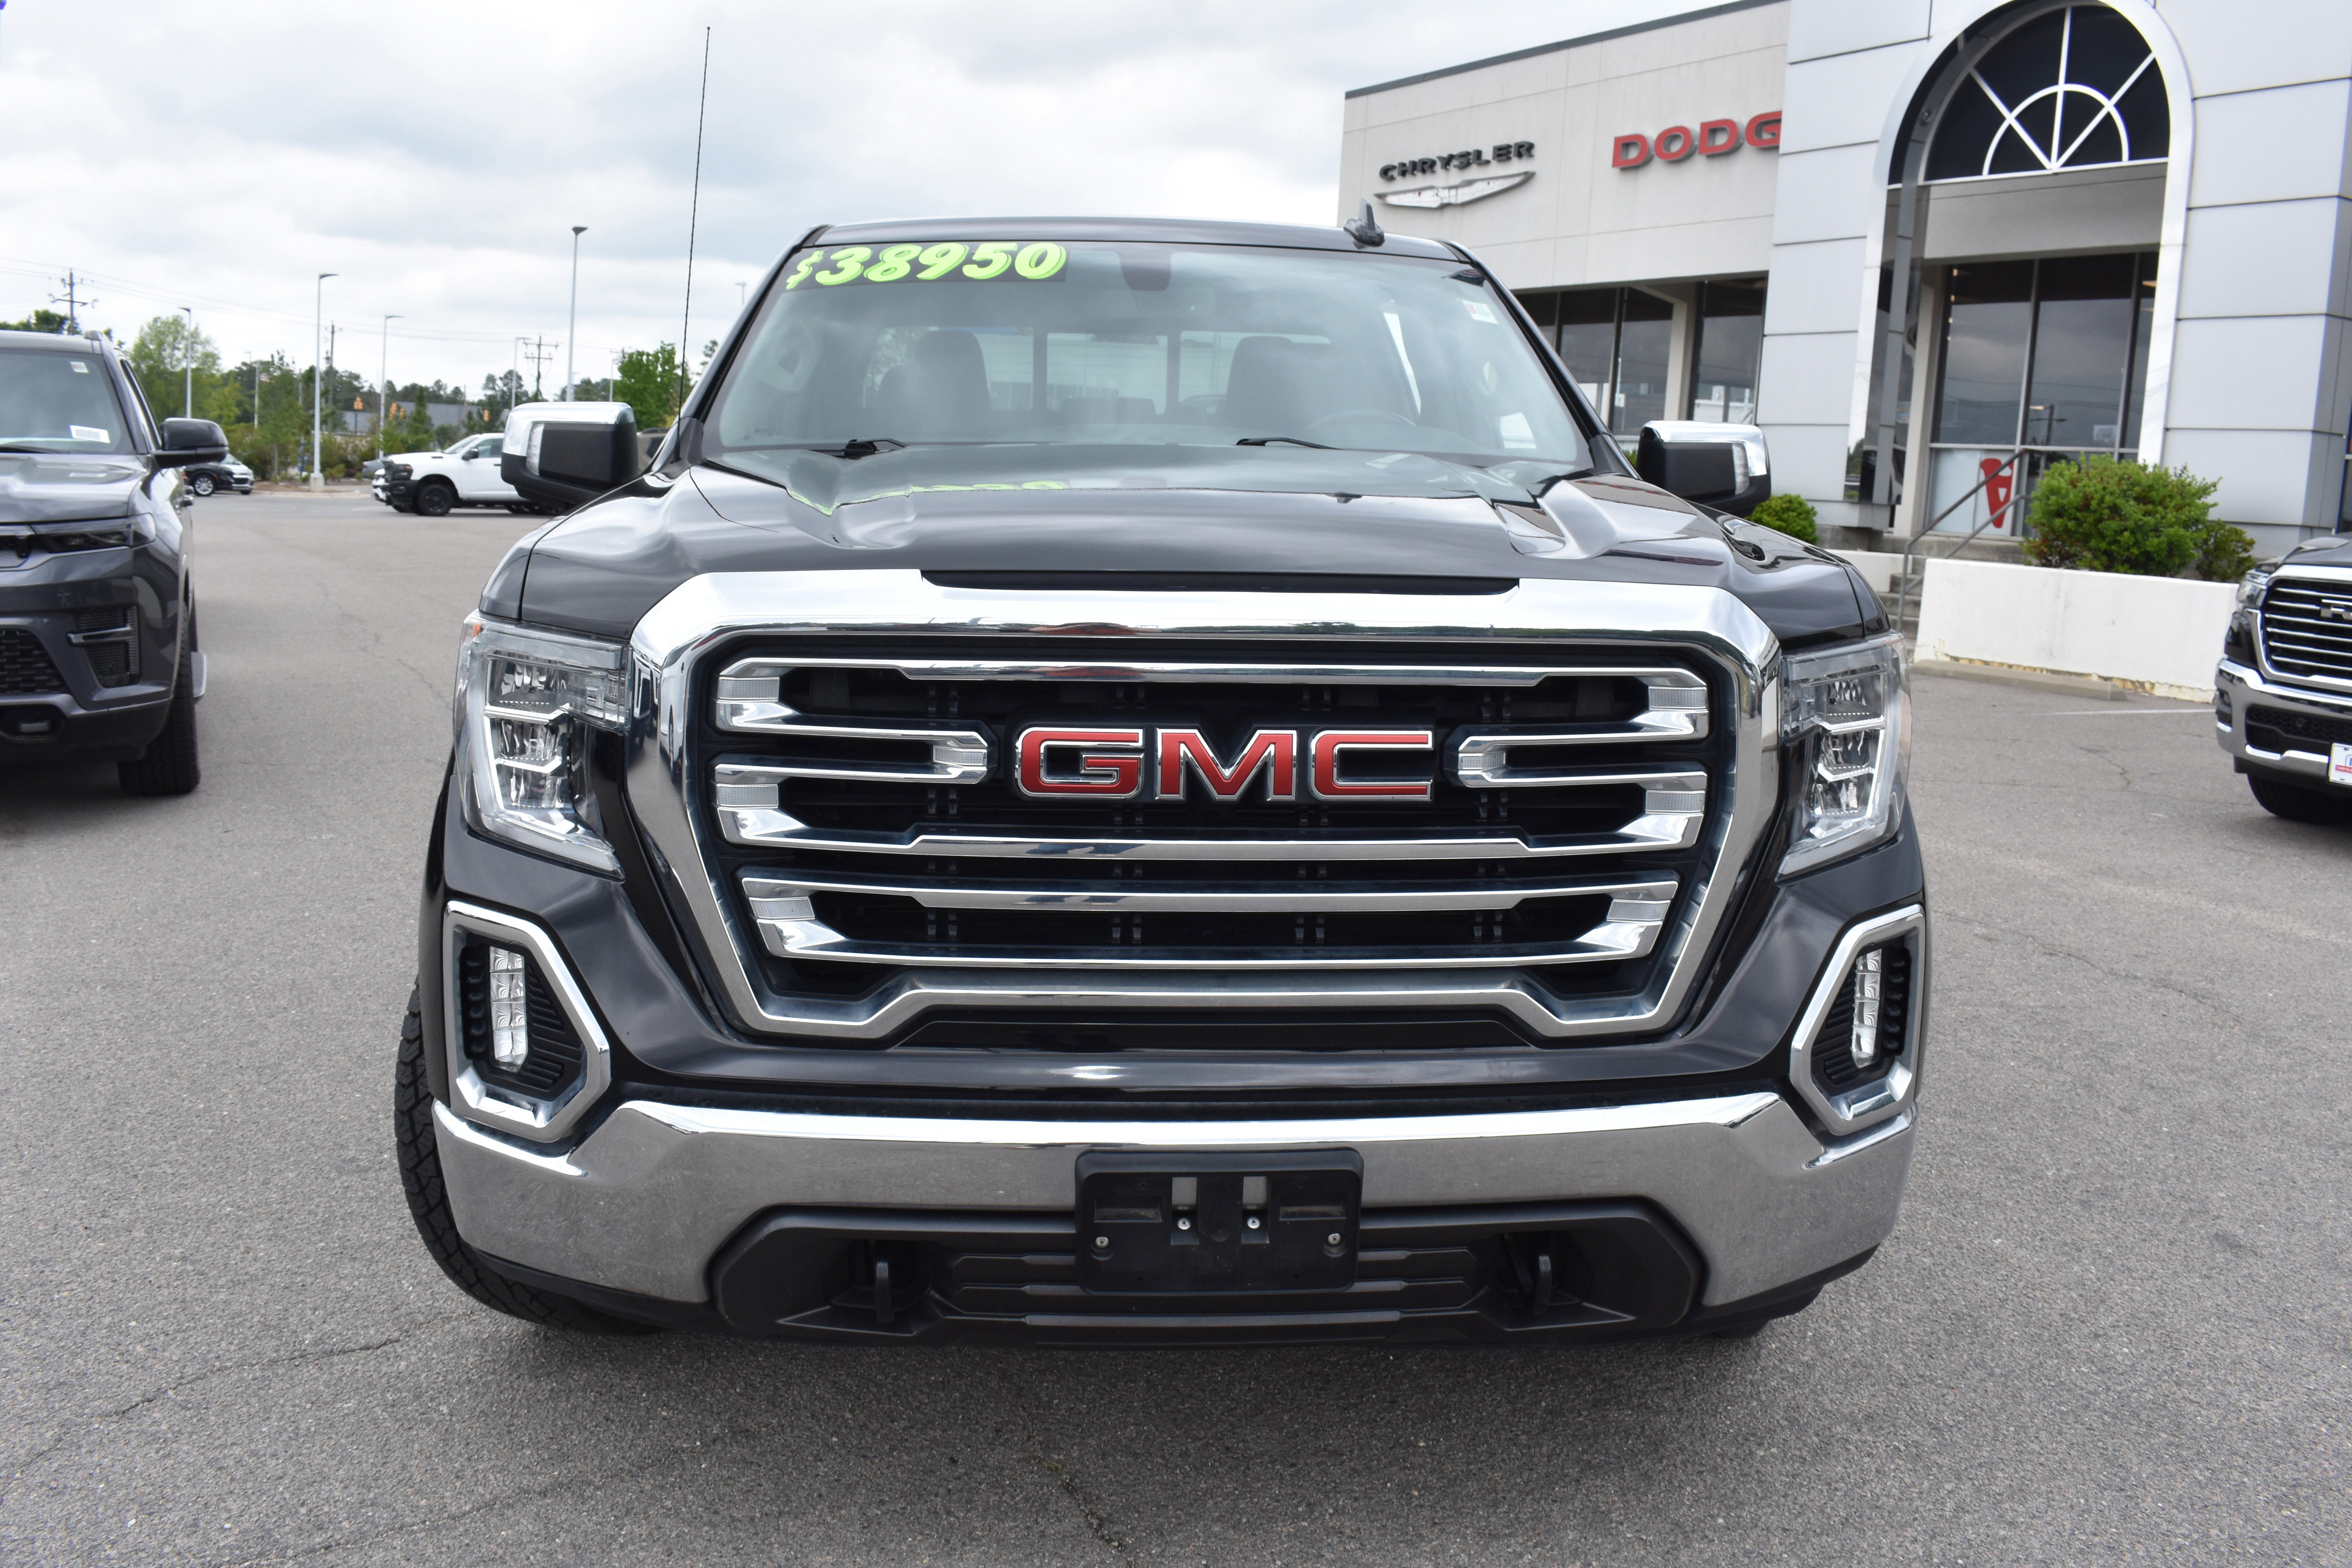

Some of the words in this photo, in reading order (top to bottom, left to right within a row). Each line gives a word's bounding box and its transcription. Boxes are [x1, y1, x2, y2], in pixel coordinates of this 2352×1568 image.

[1379, 141, 1534, 181] CHRYSLER
[786, 243, 1066, 290] $38950
[1015, 727, 1434, 800] GMC
